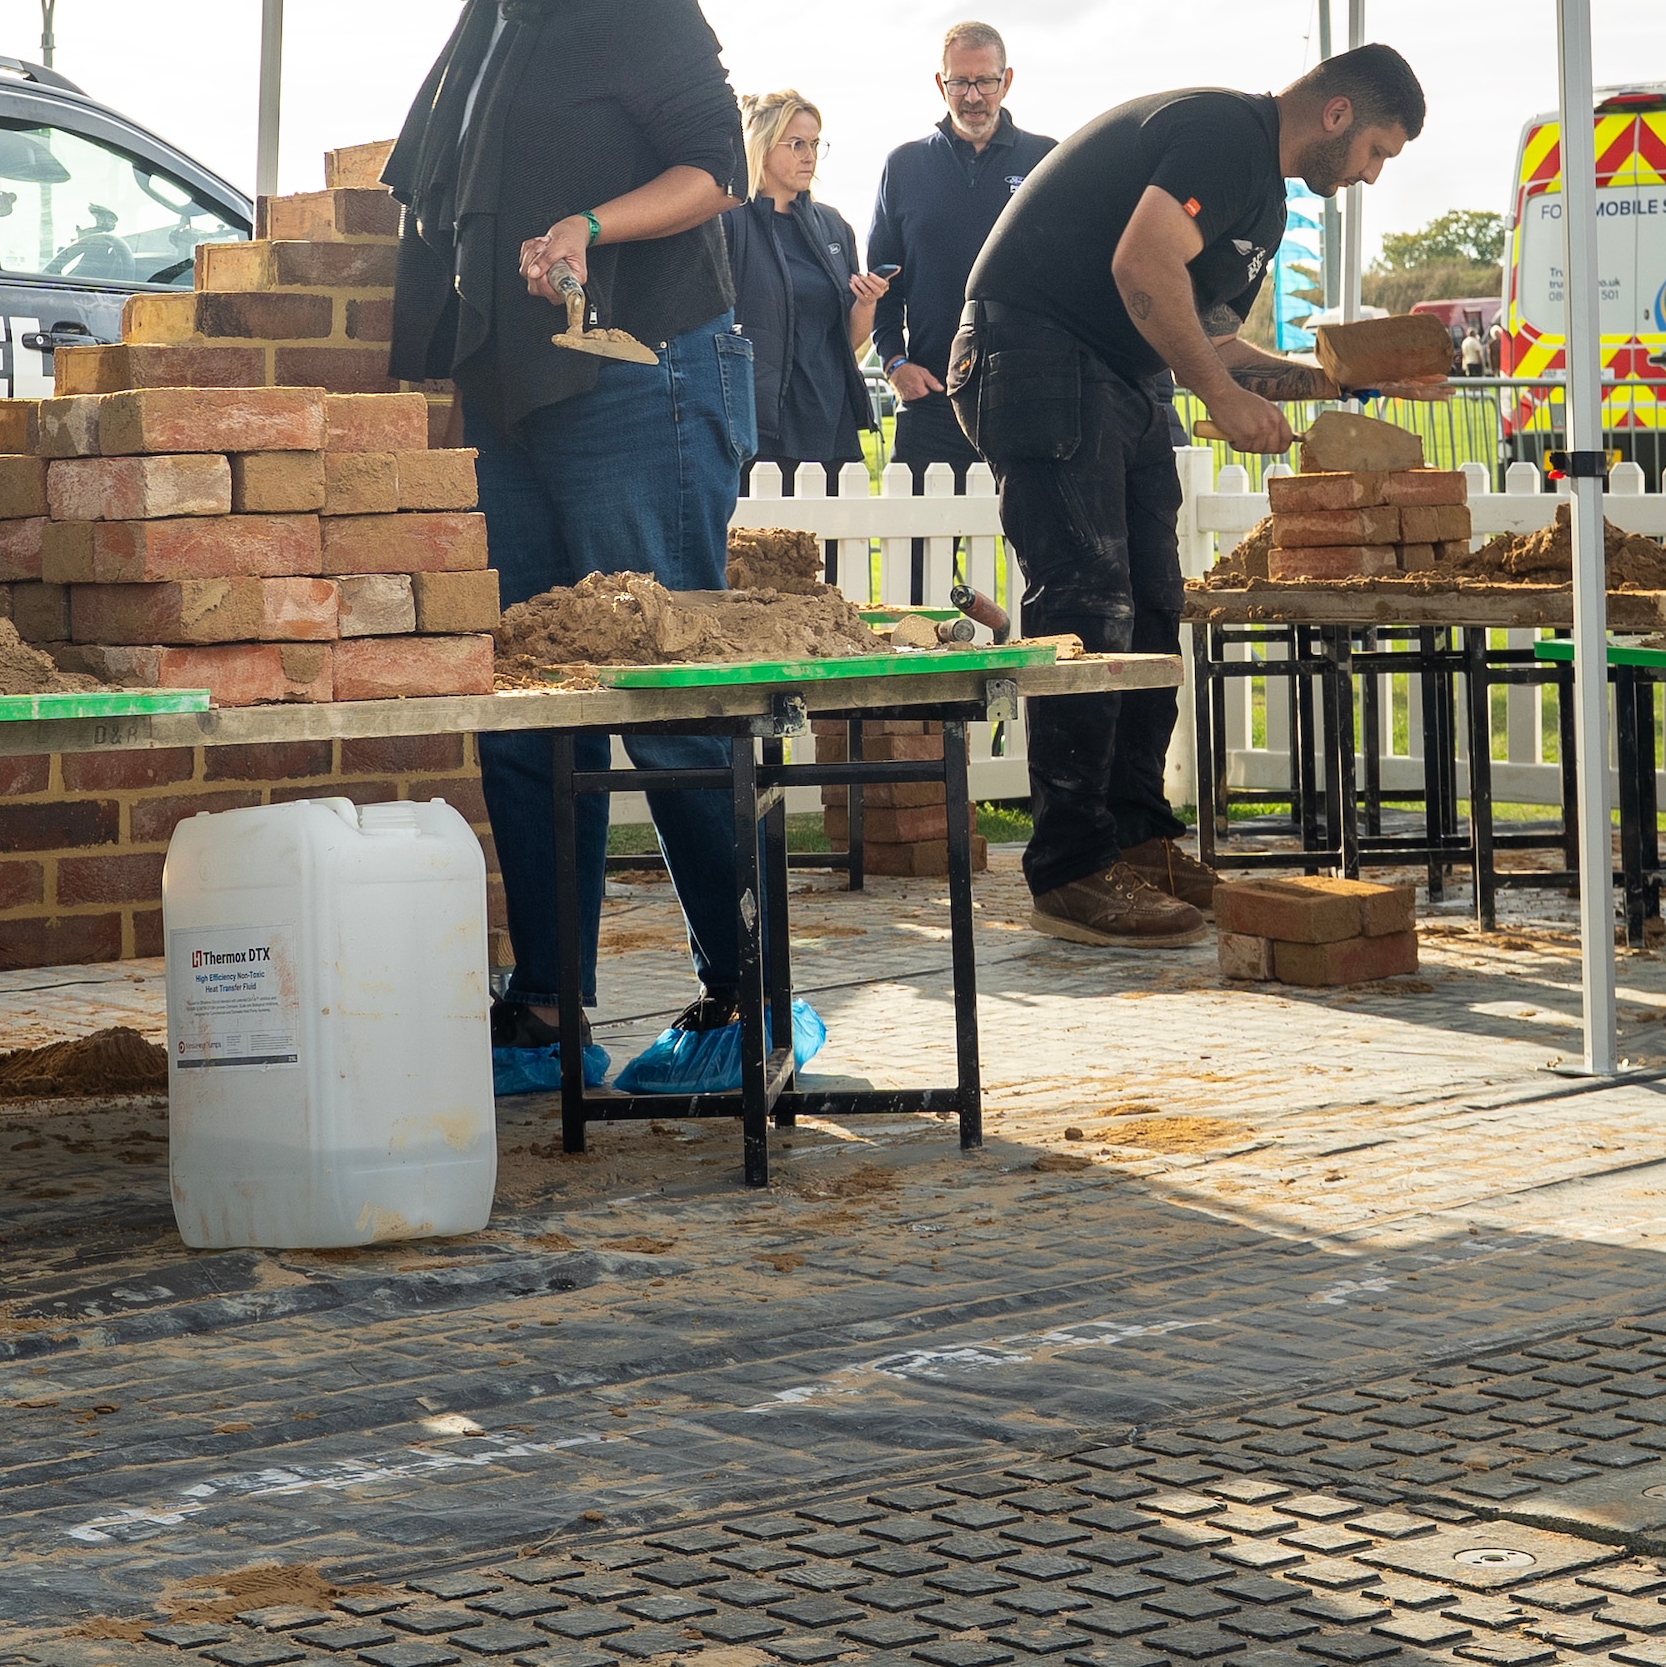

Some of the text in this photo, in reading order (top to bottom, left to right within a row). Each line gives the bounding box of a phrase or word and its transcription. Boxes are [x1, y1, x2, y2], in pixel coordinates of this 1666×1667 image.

[1596, 198, 1659, 218] MOBILE
[203, 946, 271, 967] Thermox DTX
[195, 970, 265, 985] High Efficiency Non-Toxic
[205, 982, 257, 994] Heat Transfer Fluid
